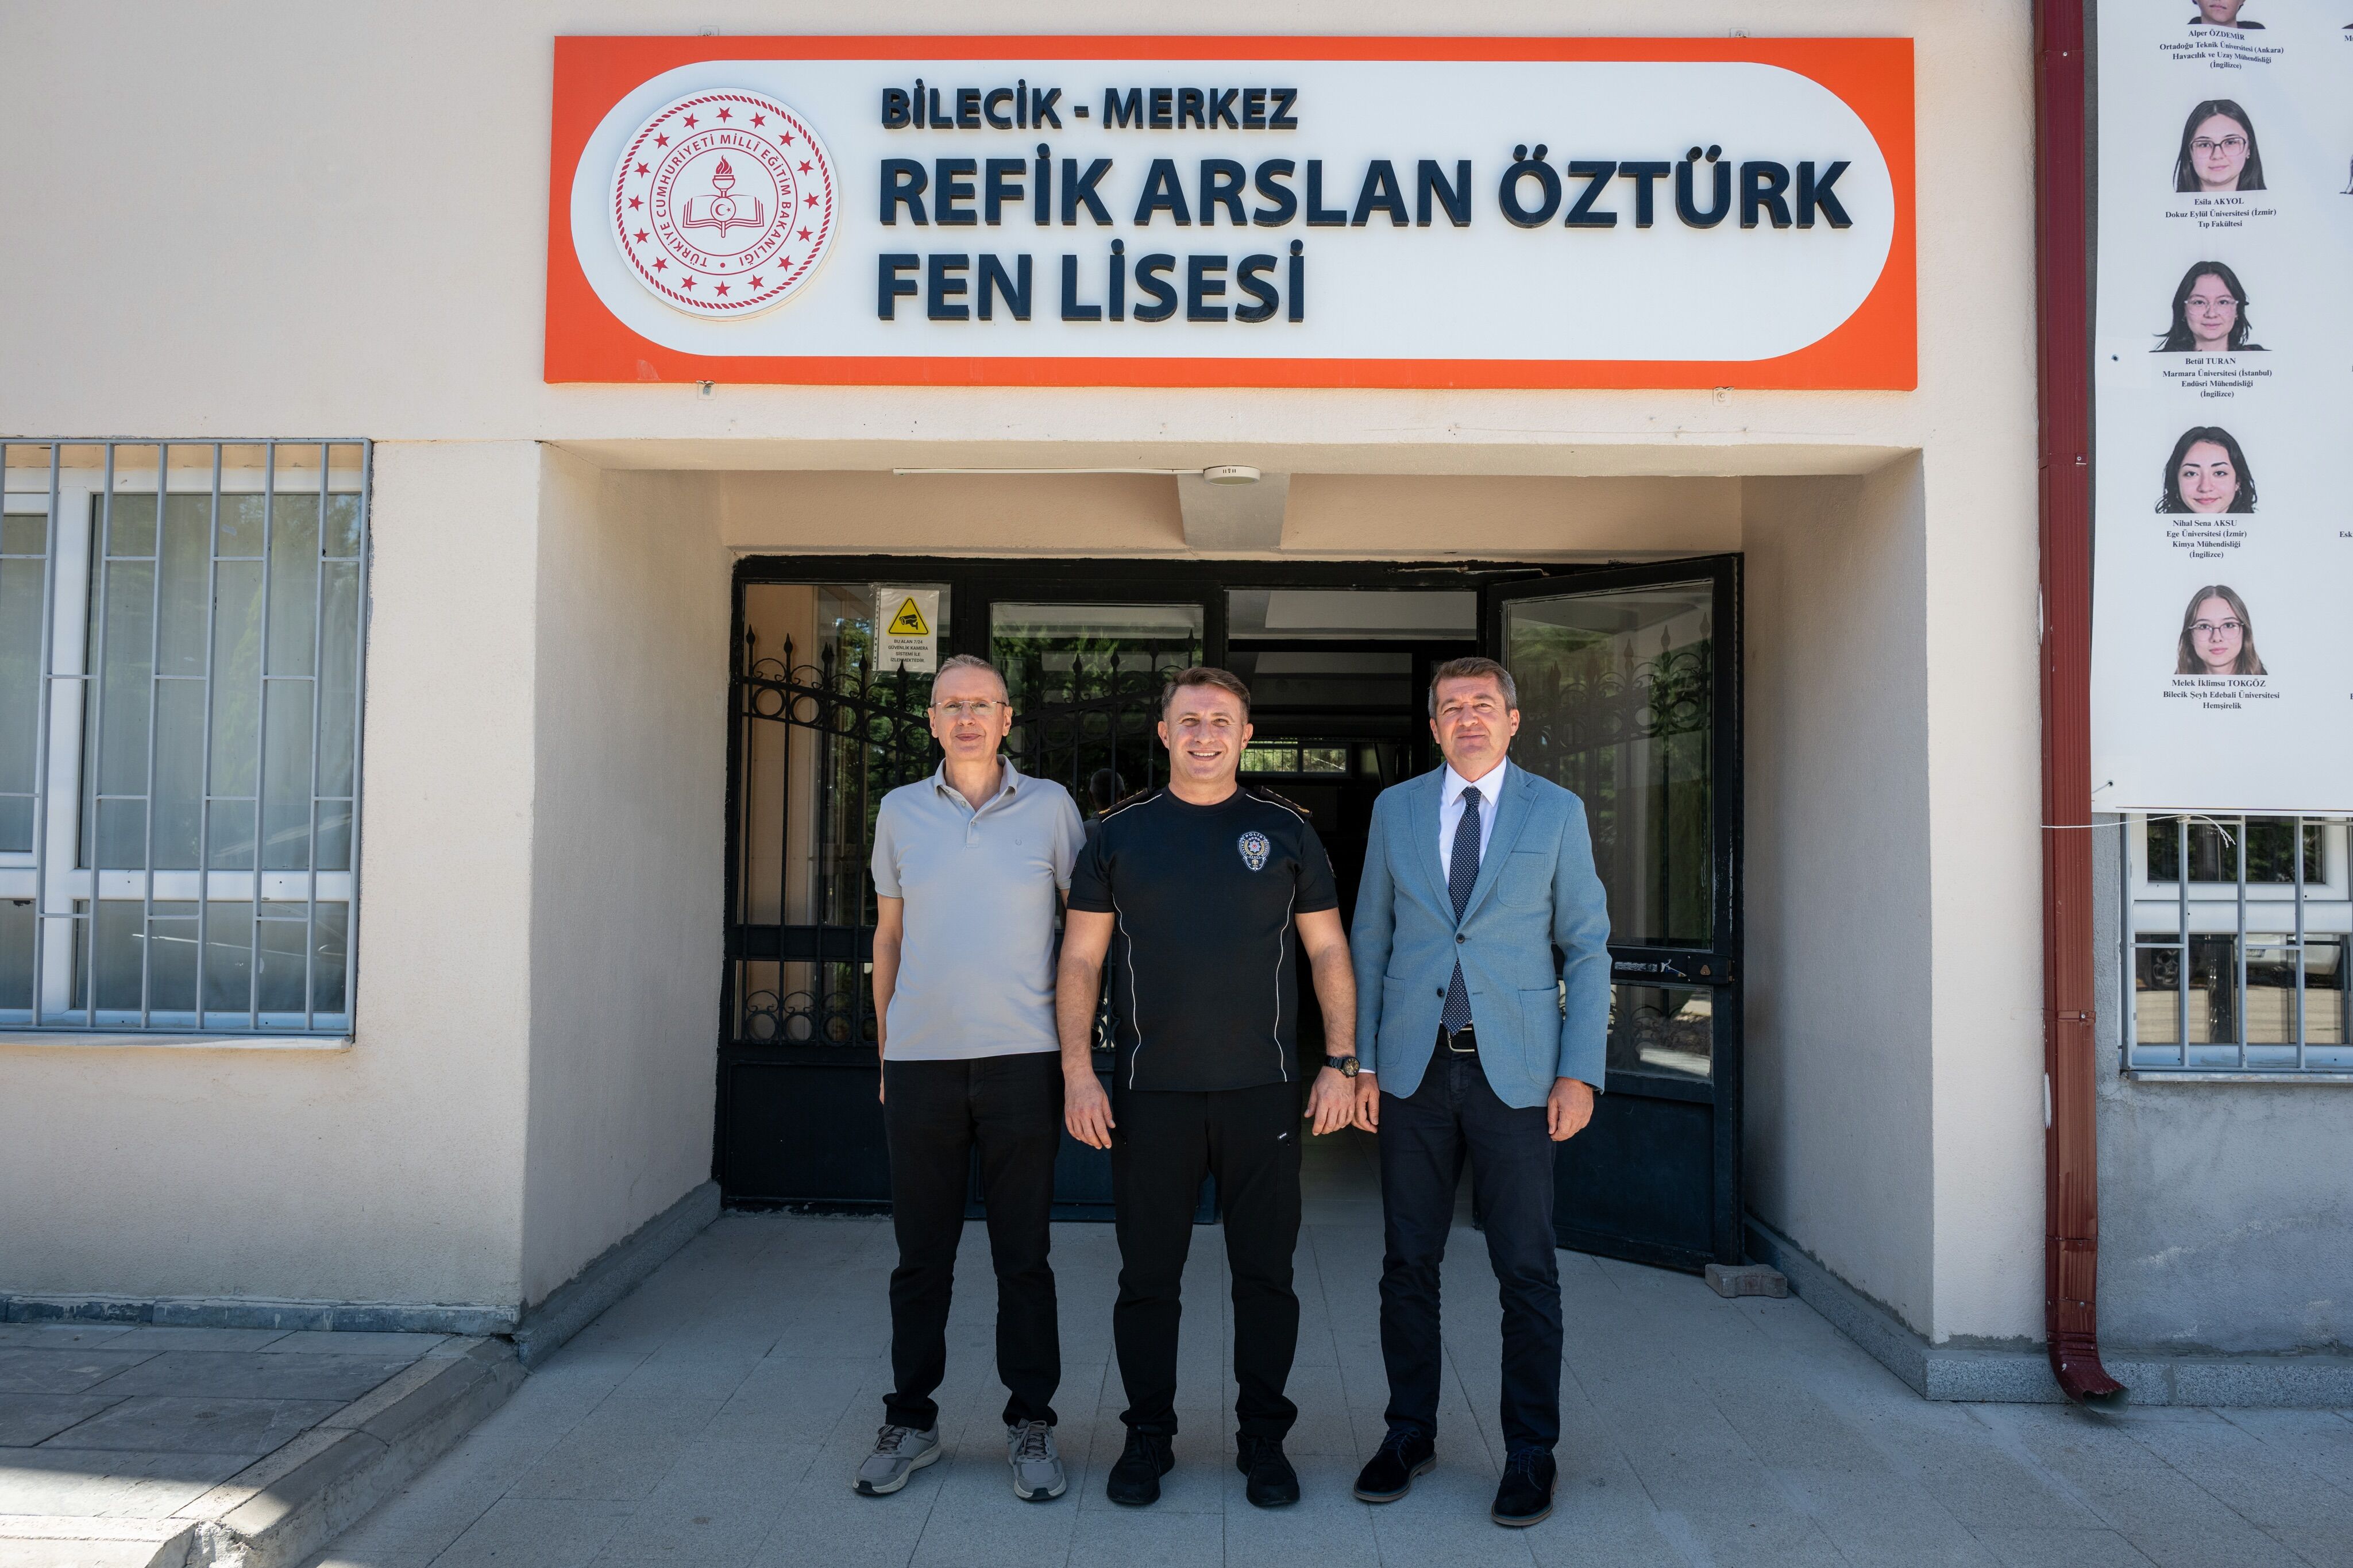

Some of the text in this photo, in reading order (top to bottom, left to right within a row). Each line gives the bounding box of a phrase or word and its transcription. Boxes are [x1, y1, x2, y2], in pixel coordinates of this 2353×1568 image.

[2209, 29, 2244, 40] ÖZDEMİR
[2220, 41, 2253, 52] Üniversitesi
[2235, 53, 2271, 64] Mühendisliği
[2210, 61, 2242, 69] (İngilizce)
[882, 79, 1297, 130] BİLECİK - MERKEZ
[880, 143, 1853, 229] REFİK ARSLAN ÖZTÜRK
[656, 133, 791, 267] TÜRKİYE CUMHURİYETİ MİLLÎ EĞİTİM BAKANLIĞI
[2251, 208, 2276, 217] (İzmir)
[878, 239, 1304, 323] FEN LİSESİ
[2239, 369, 2272, 377] (İstanbul)
[2201, 389, 2234, 398] (İngilizce)
[2223, 529, 2247, 538] (İzmir)
[2189, 550, 2224, 559] (İngilizce)
[2198, 678, 2225, 686] İklimsu
[2227, 678, 2266, 687] TOKGÖZ
[2239, 690, 2279, 699] Üniversitesi
